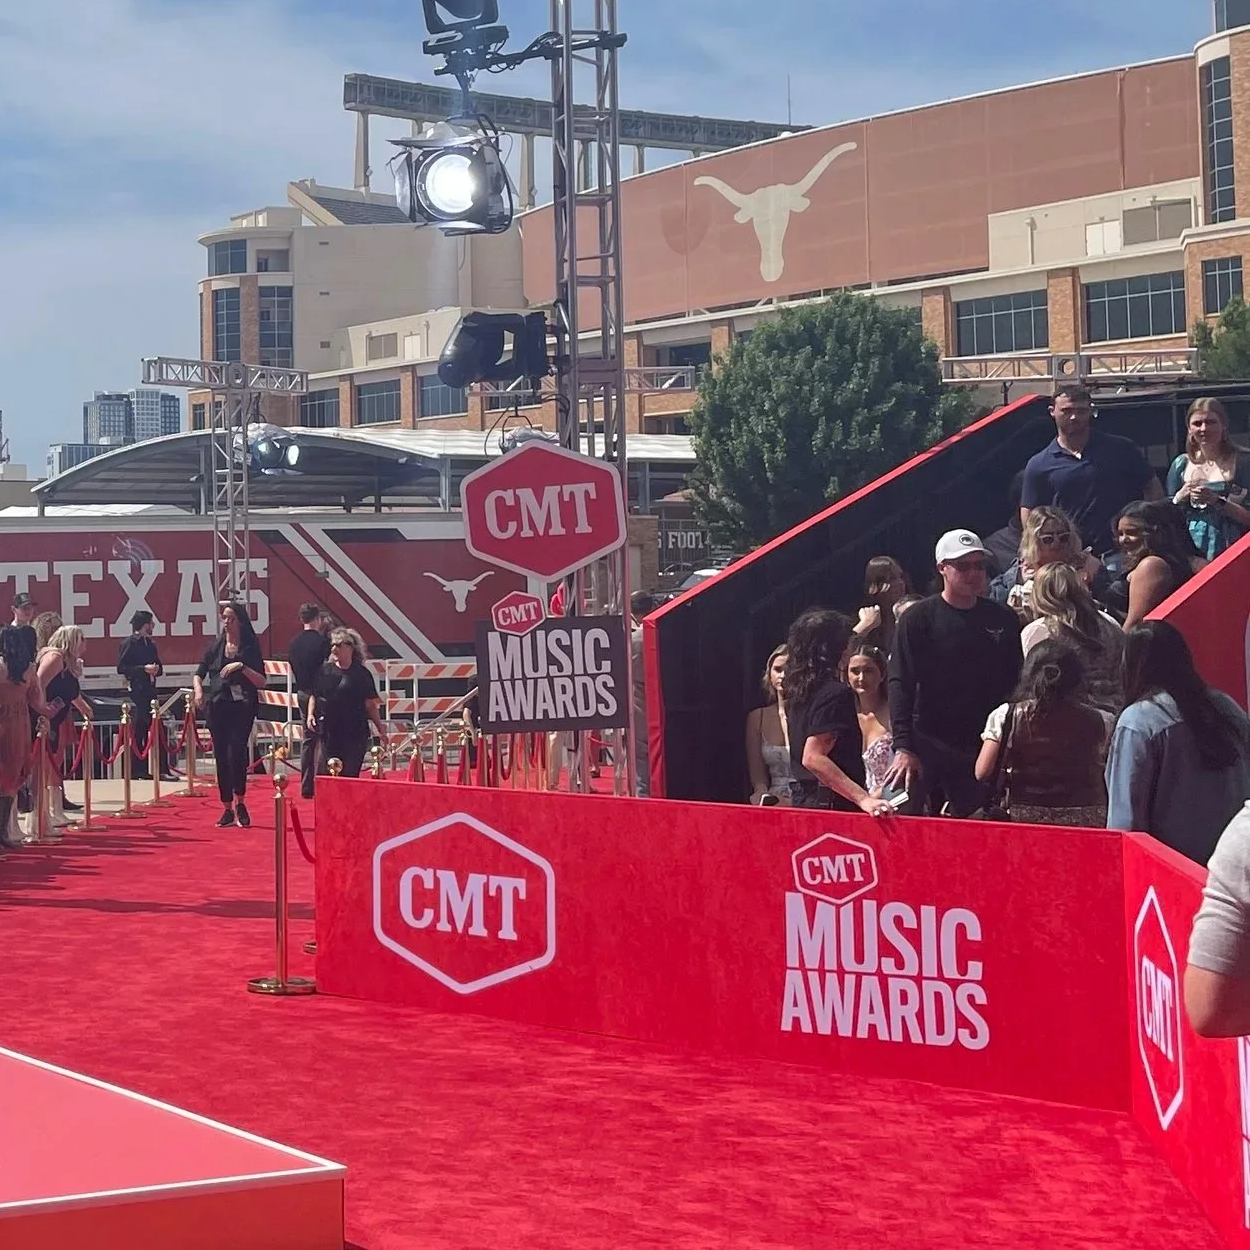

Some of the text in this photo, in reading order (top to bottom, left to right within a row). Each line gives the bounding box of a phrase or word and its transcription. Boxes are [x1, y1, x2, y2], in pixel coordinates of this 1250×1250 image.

[484, 483, 596, 539] CMT
[498, 602, 538, 625] CMT
[488, 628, 611, 680] MUSIC
[489, 674, 617, 722] AWARDS
[802, 853, 865, 885] CMT
[400, 866, 526, 940] CMT
[785, 892, 983, 980] MUSIC
[781, 969, 990, 1050] AWARDS
[1142, 955, 1174, 1062] CMT
